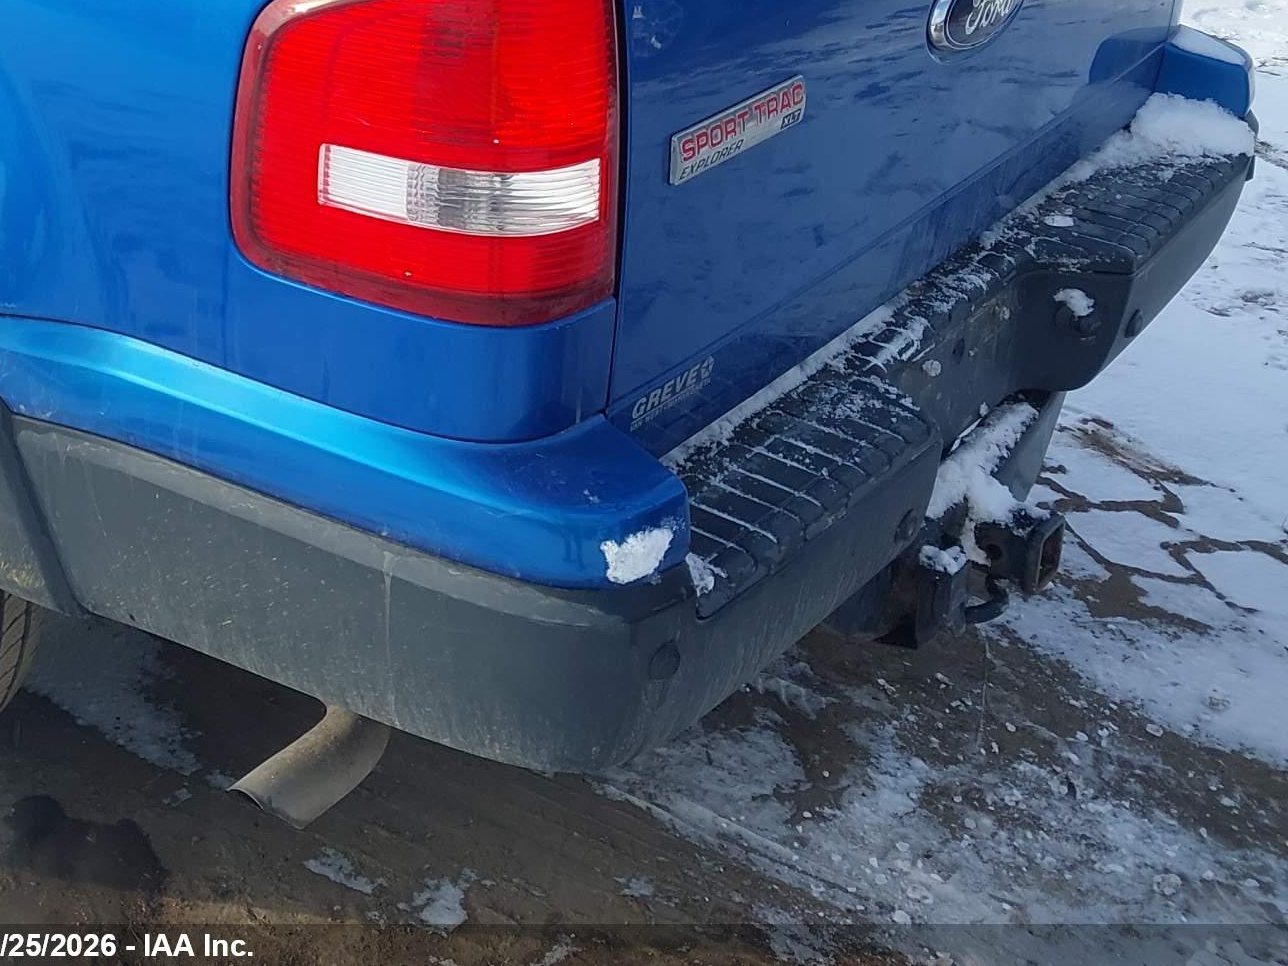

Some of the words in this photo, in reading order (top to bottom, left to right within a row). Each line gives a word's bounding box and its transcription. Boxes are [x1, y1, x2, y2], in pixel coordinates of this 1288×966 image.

[680, 110, 751, 164] SPORT
[753, 82, 805, 126] TRAC
[781, 109, 802, 130] XLT
[678, 138, 745, 181] EXPLORER
